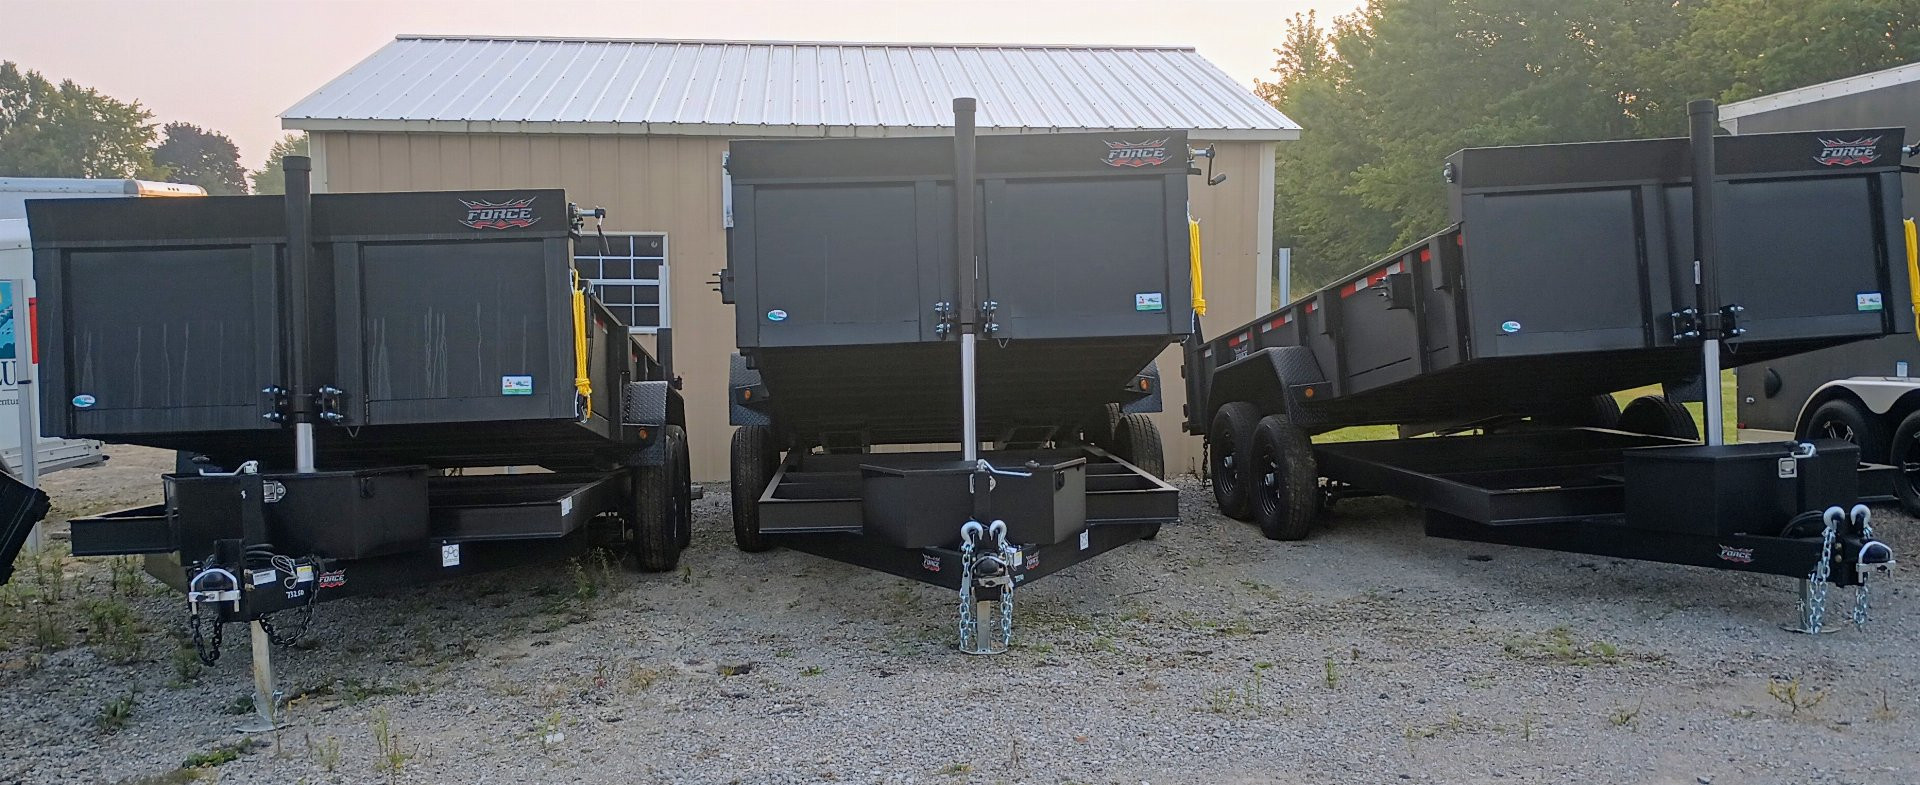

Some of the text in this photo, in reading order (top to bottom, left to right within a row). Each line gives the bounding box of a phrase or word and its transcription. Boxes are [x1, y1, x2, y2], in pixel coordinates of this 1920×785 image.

[1108, 147, 1166, 159] FORCE
[1821, 145, 1877, 157] FORCE
[467, 207, 533, 220] FORCE
[0, 361, 17, 386] U
[1721, 549, 1752, 560] FORCE
[319, 574, 345, 583] FORCE
